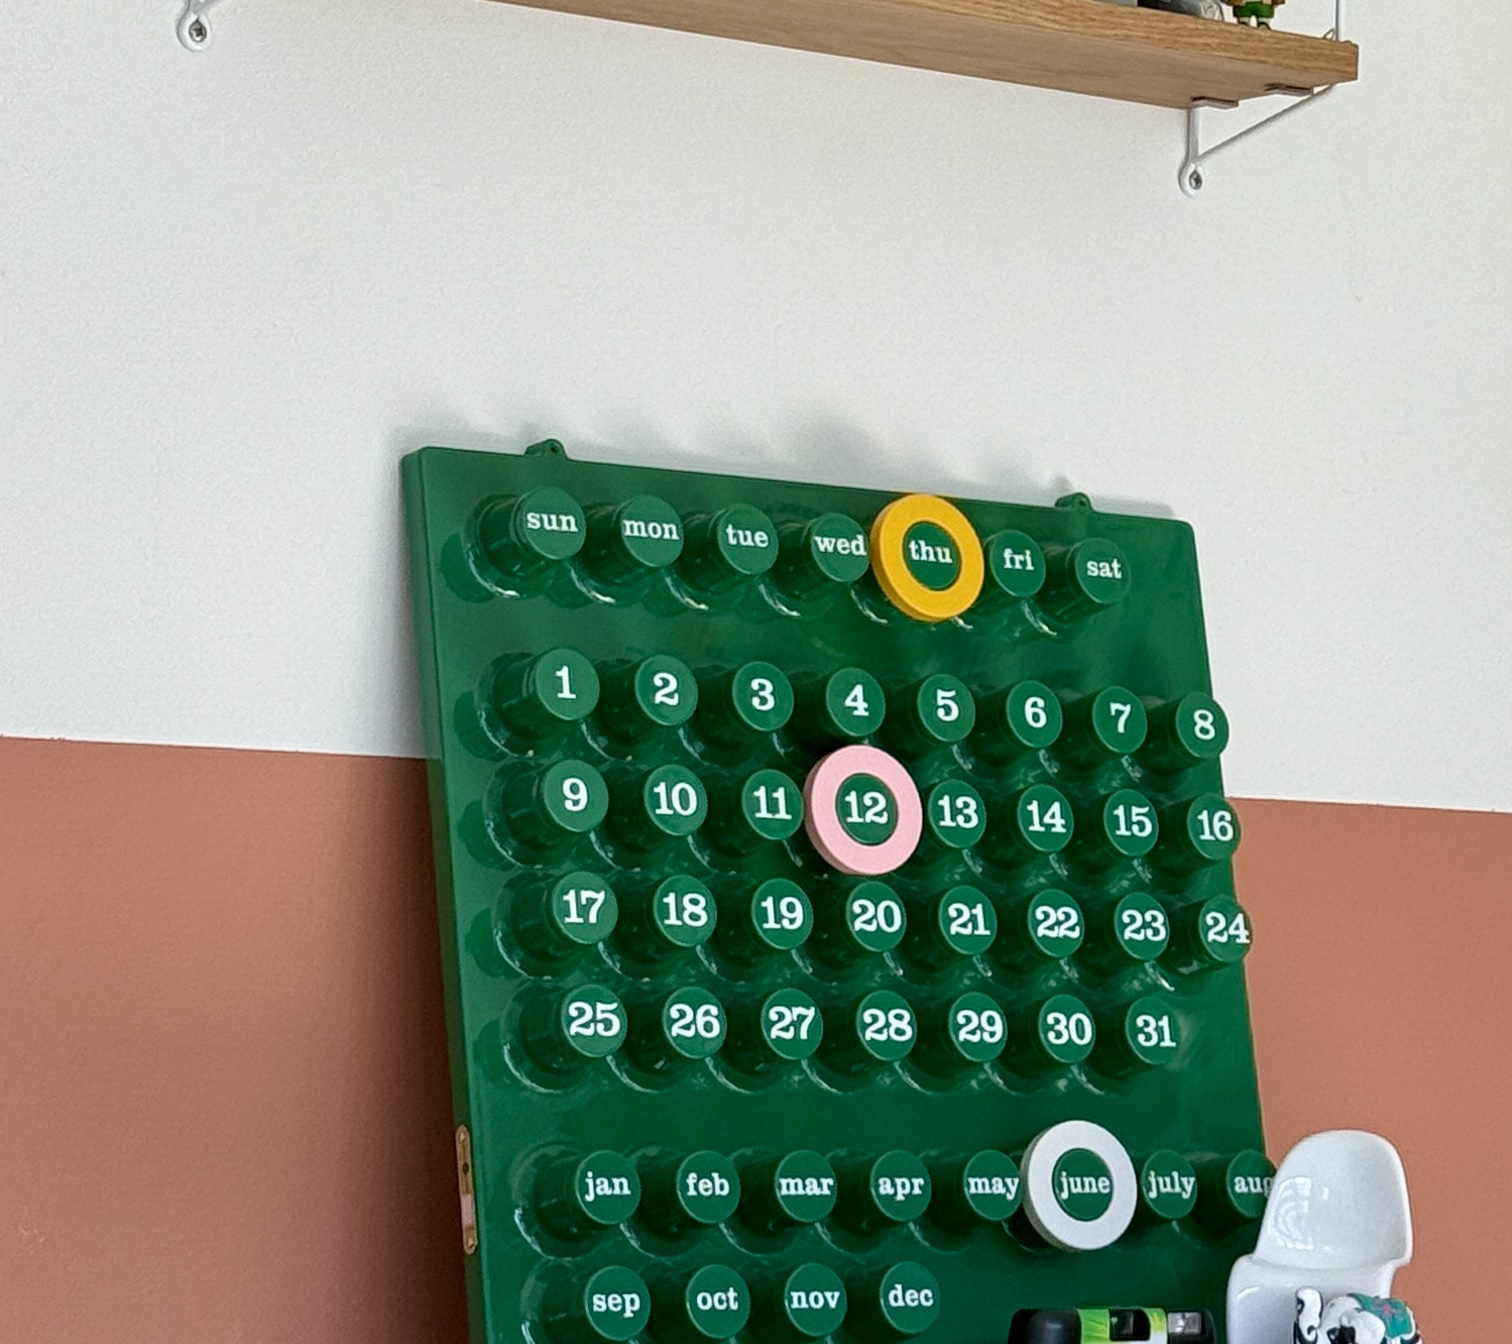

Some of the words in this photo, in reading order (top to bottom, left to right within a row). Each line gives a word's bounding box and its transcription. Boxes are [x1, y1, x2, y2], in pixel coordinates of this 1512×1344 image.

[526, 512, 578, 533] sun
[622, 519, 680, 540] mon
[725, 524, 769, 548] tue
[813, 534, 868, 556] wed
[908, 539, 953, 564] thu
[1003, 548, 1034, 571] fri
[1086, 558, 1122, 579] sat
[555, 665, 577, 699] 1
[653, 672, 679, 706] 2
[750, 678, 775, 711] 3
[844, 684, 869, 717] 4
[936, 689, 959, 722] 5
[1024, 696, 1047, 728] 6
[1110, 702, 1131, 733] 7
[1193, 709, 1216, 740] 8
[562, 777, 588, 812] 9
[653, 781, 698, 816] 10
[753, 785, 793, 820] 11
[844, 790, 889, 825] 12
[937, 794, 979, 829] 13
[1026, 799, 1067, 833] 14
[1113, 804, 1153, 837] 15
[1197, 809, 1234, 842] 16
[562, 889, 606, 924] 17
[662, 892, 708, 927] 18
[760, 895, 804, 930] 19
[852, 898, 902, 933] 20
[947, 902, 991, 936] 21
[1035, 905, 1081, 939] 22
[1121, 909, 1167, 942] 23
[1205, 911, 1250, 944] 24
[568, 1001, 621, 1037] 25
[669, 1003, 721, 1039] 26
[768, 1005, 816, 1040] 27
[862, 1008, 913, 1042] 28
[956, 1009, 1004, 1043] 29
[1046, 1012, 1093, 1046] 30
[1135, 1014, 1177, 1047] 31
[584, 1171, 631, 1202] jan
[686, 1172, 730, 1196] feb
[779, 1177, 834, 1196] mar
[878, 1177, 925, 1201] apr
[967, 1177, 1020, 1201] may
[1060, 1171, 1111, 1199] june
[1148, 1170, 1196, 1199] july
[592, 1293, 641, 1318] sep
[696, 1287, 739, 1310] oct
[790, 1291, 840, 1309] nov
[888, 1283, 934, 1307] dec
